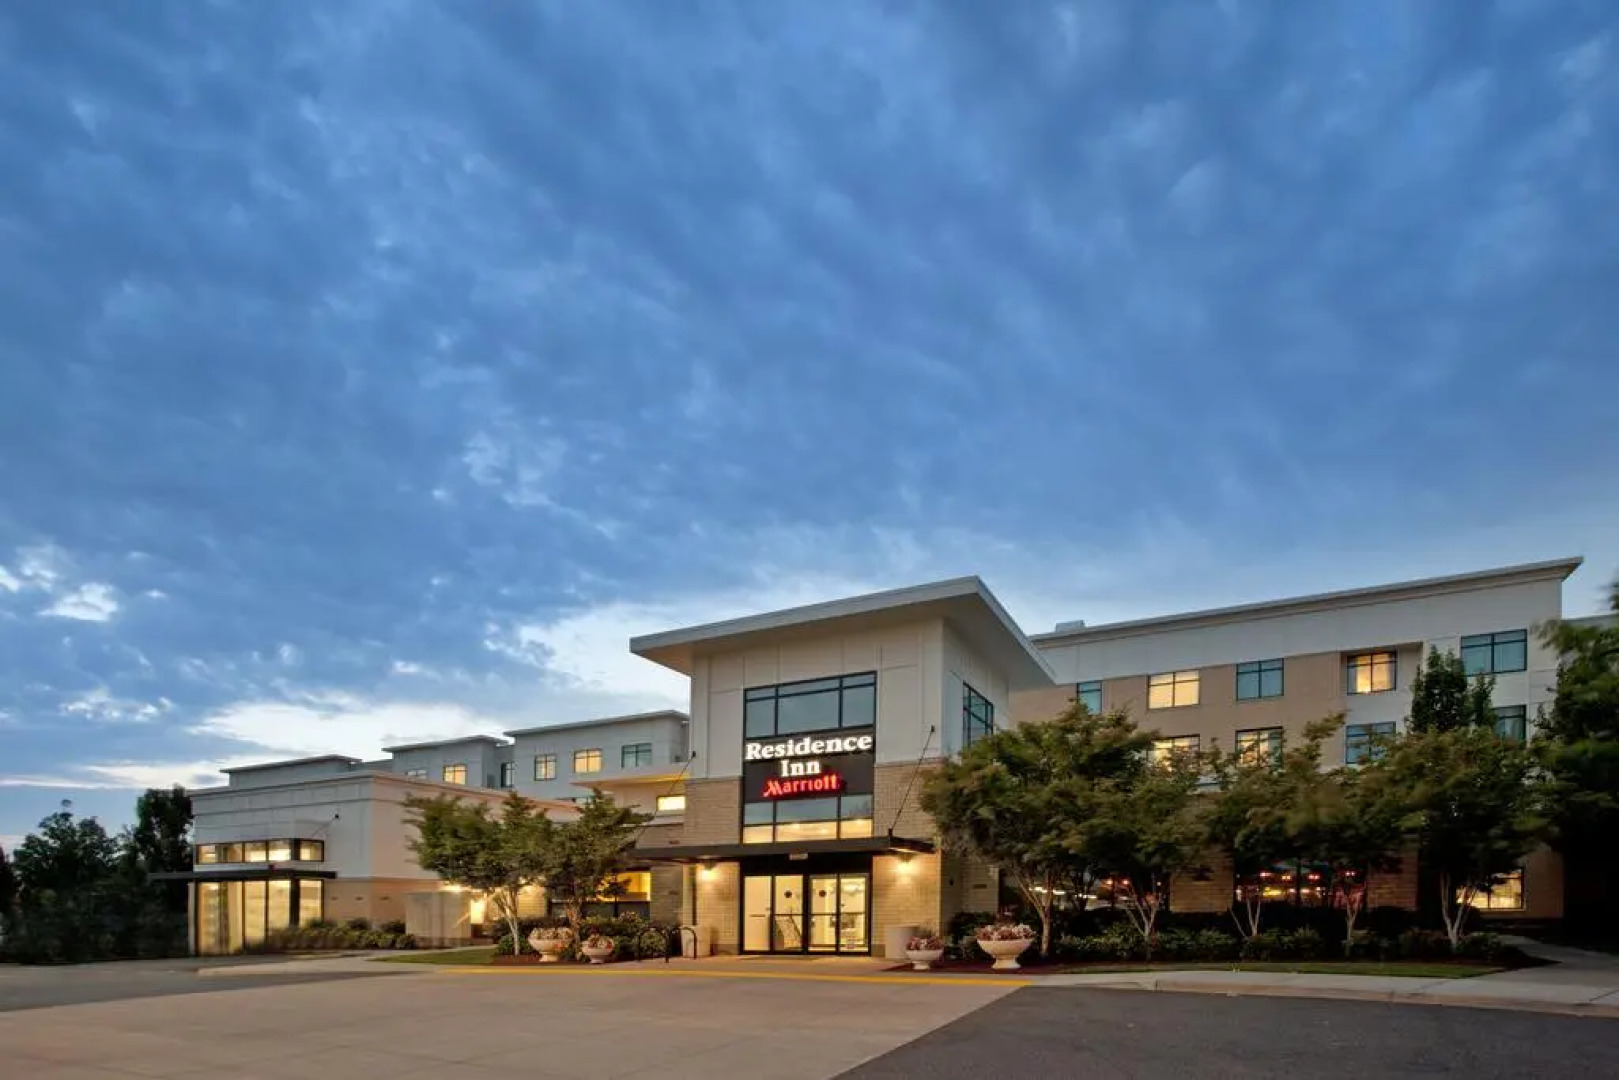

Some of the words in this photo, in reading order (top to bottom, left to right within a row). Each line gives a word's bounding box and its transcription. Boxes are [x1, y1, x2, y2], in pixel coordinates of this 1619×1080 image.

[745, 735, 872, 760] Residence
[780, 759, 821, 777] Inn
[763, 774, 838, 797] Marriott
